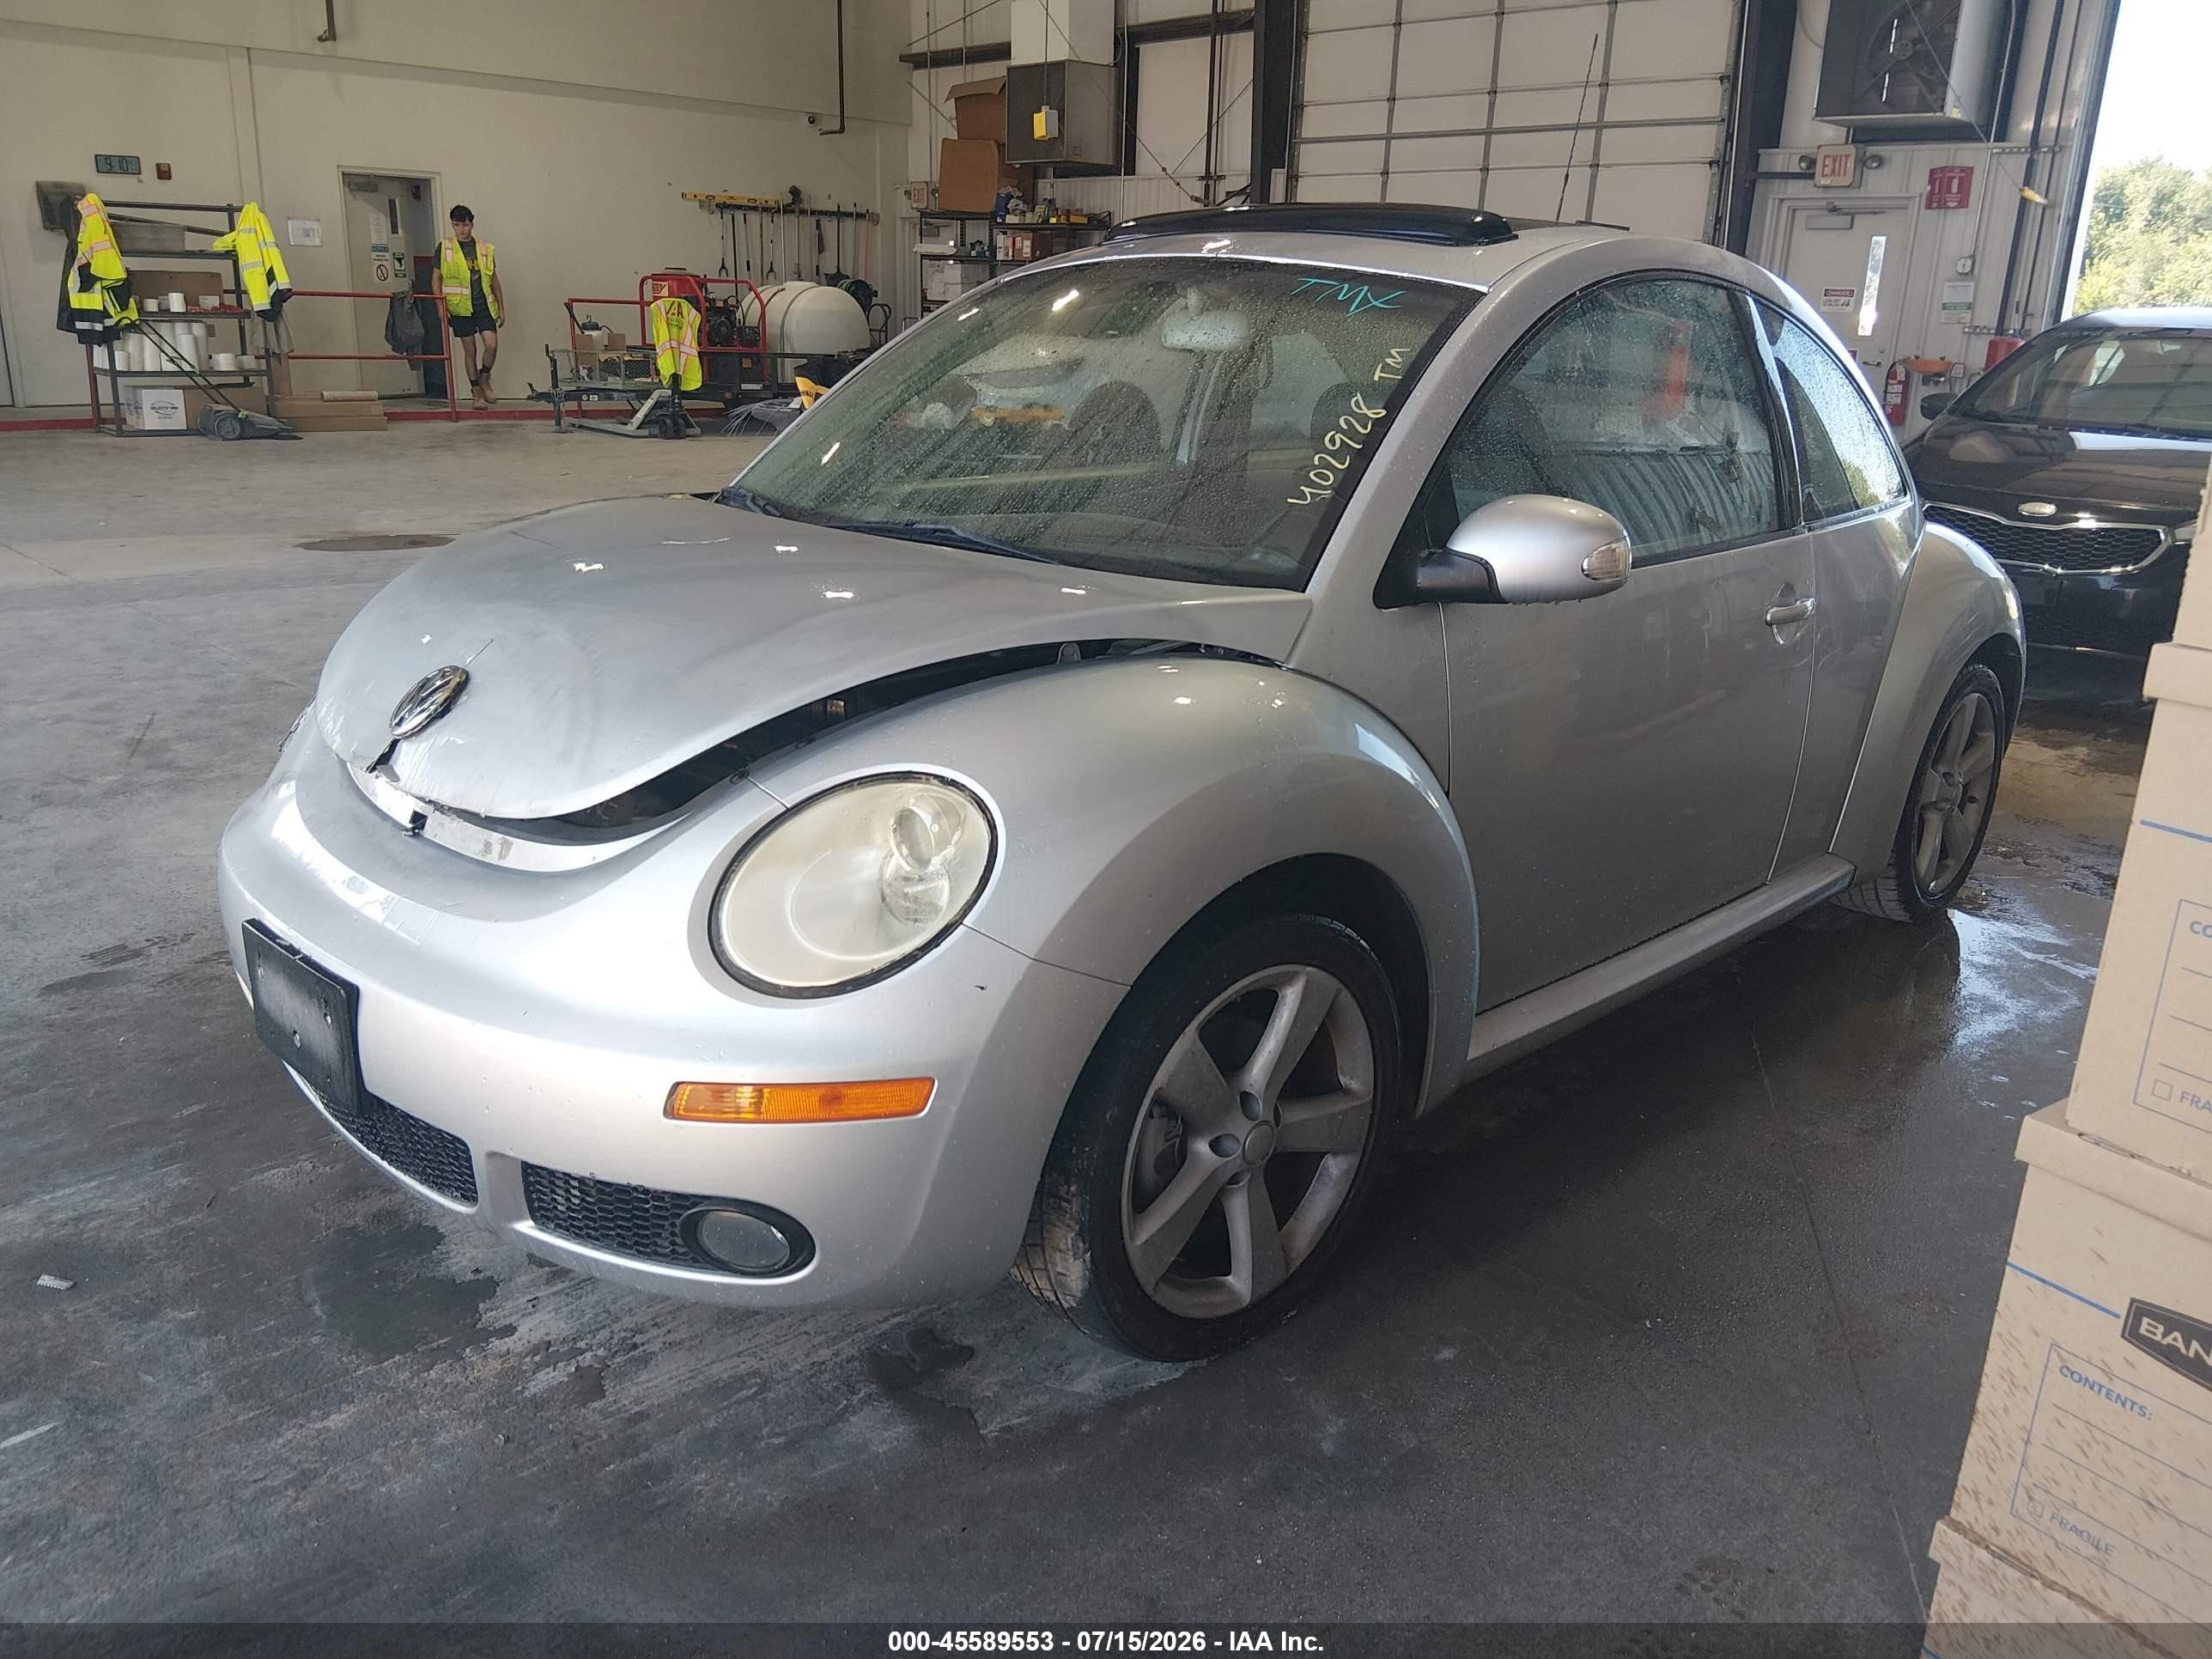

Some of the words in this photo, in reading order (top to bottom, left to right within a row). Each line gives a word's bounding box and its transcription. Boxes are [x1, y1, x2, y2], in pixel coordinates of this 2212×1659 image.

[1821, 154, 1851, 178] EXIT
[1286, 392, 1388, 505] 402928
[1373, 347, 1411, 381] TM
[2139, 1316, 2212, 1367] BAN
[2058, 1364, 2153, 1421] CONTENTS:
